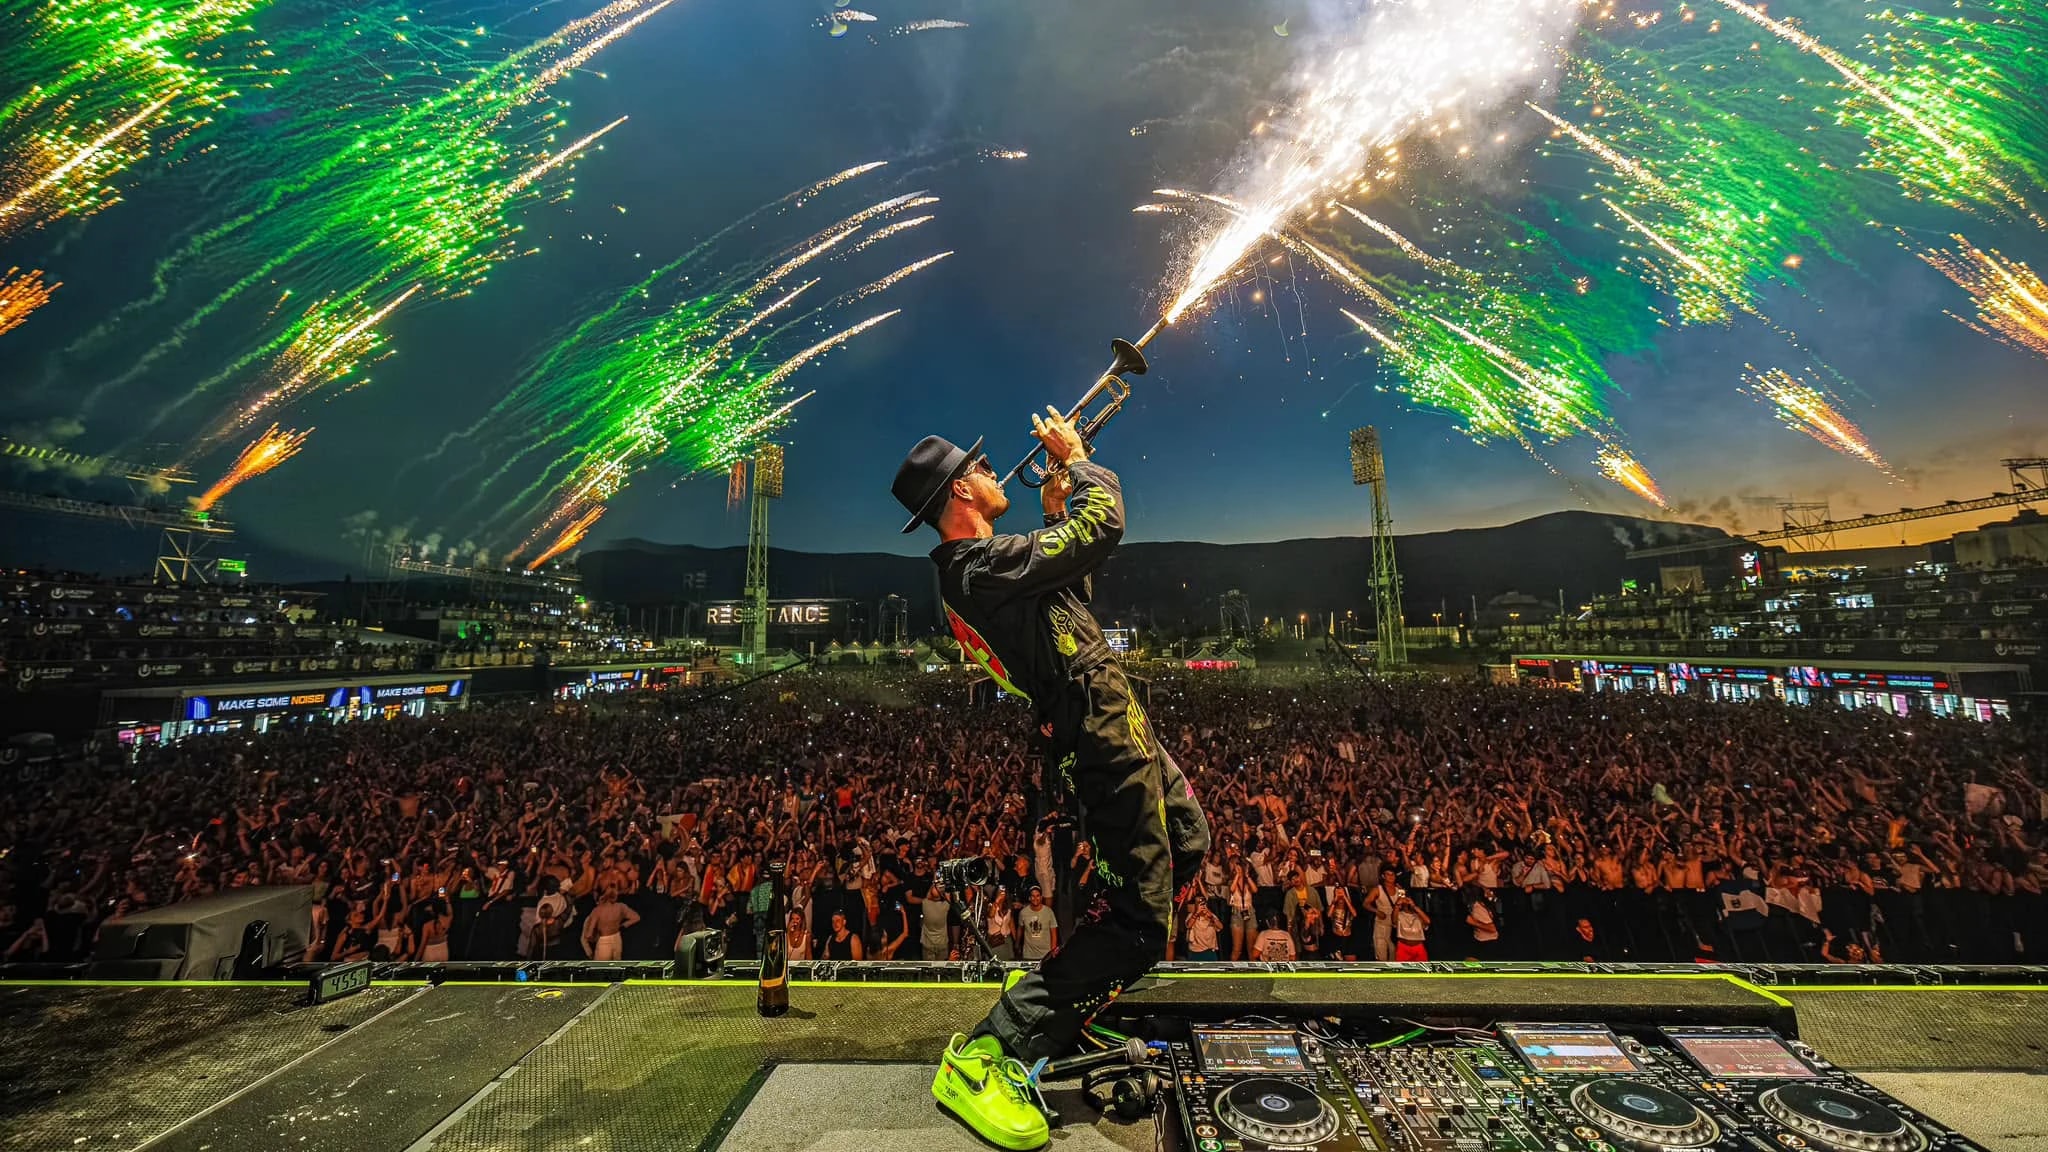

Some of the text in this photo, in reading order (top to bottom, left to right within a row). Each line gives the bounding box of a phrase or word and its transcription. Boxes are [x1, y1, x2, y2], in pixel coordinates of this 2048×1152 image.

[377, 688, 401, 698] MAKE
[402, 686, 424, 696] SOME
[217, 694, 325, 711] MAKE SOME NOISE!
